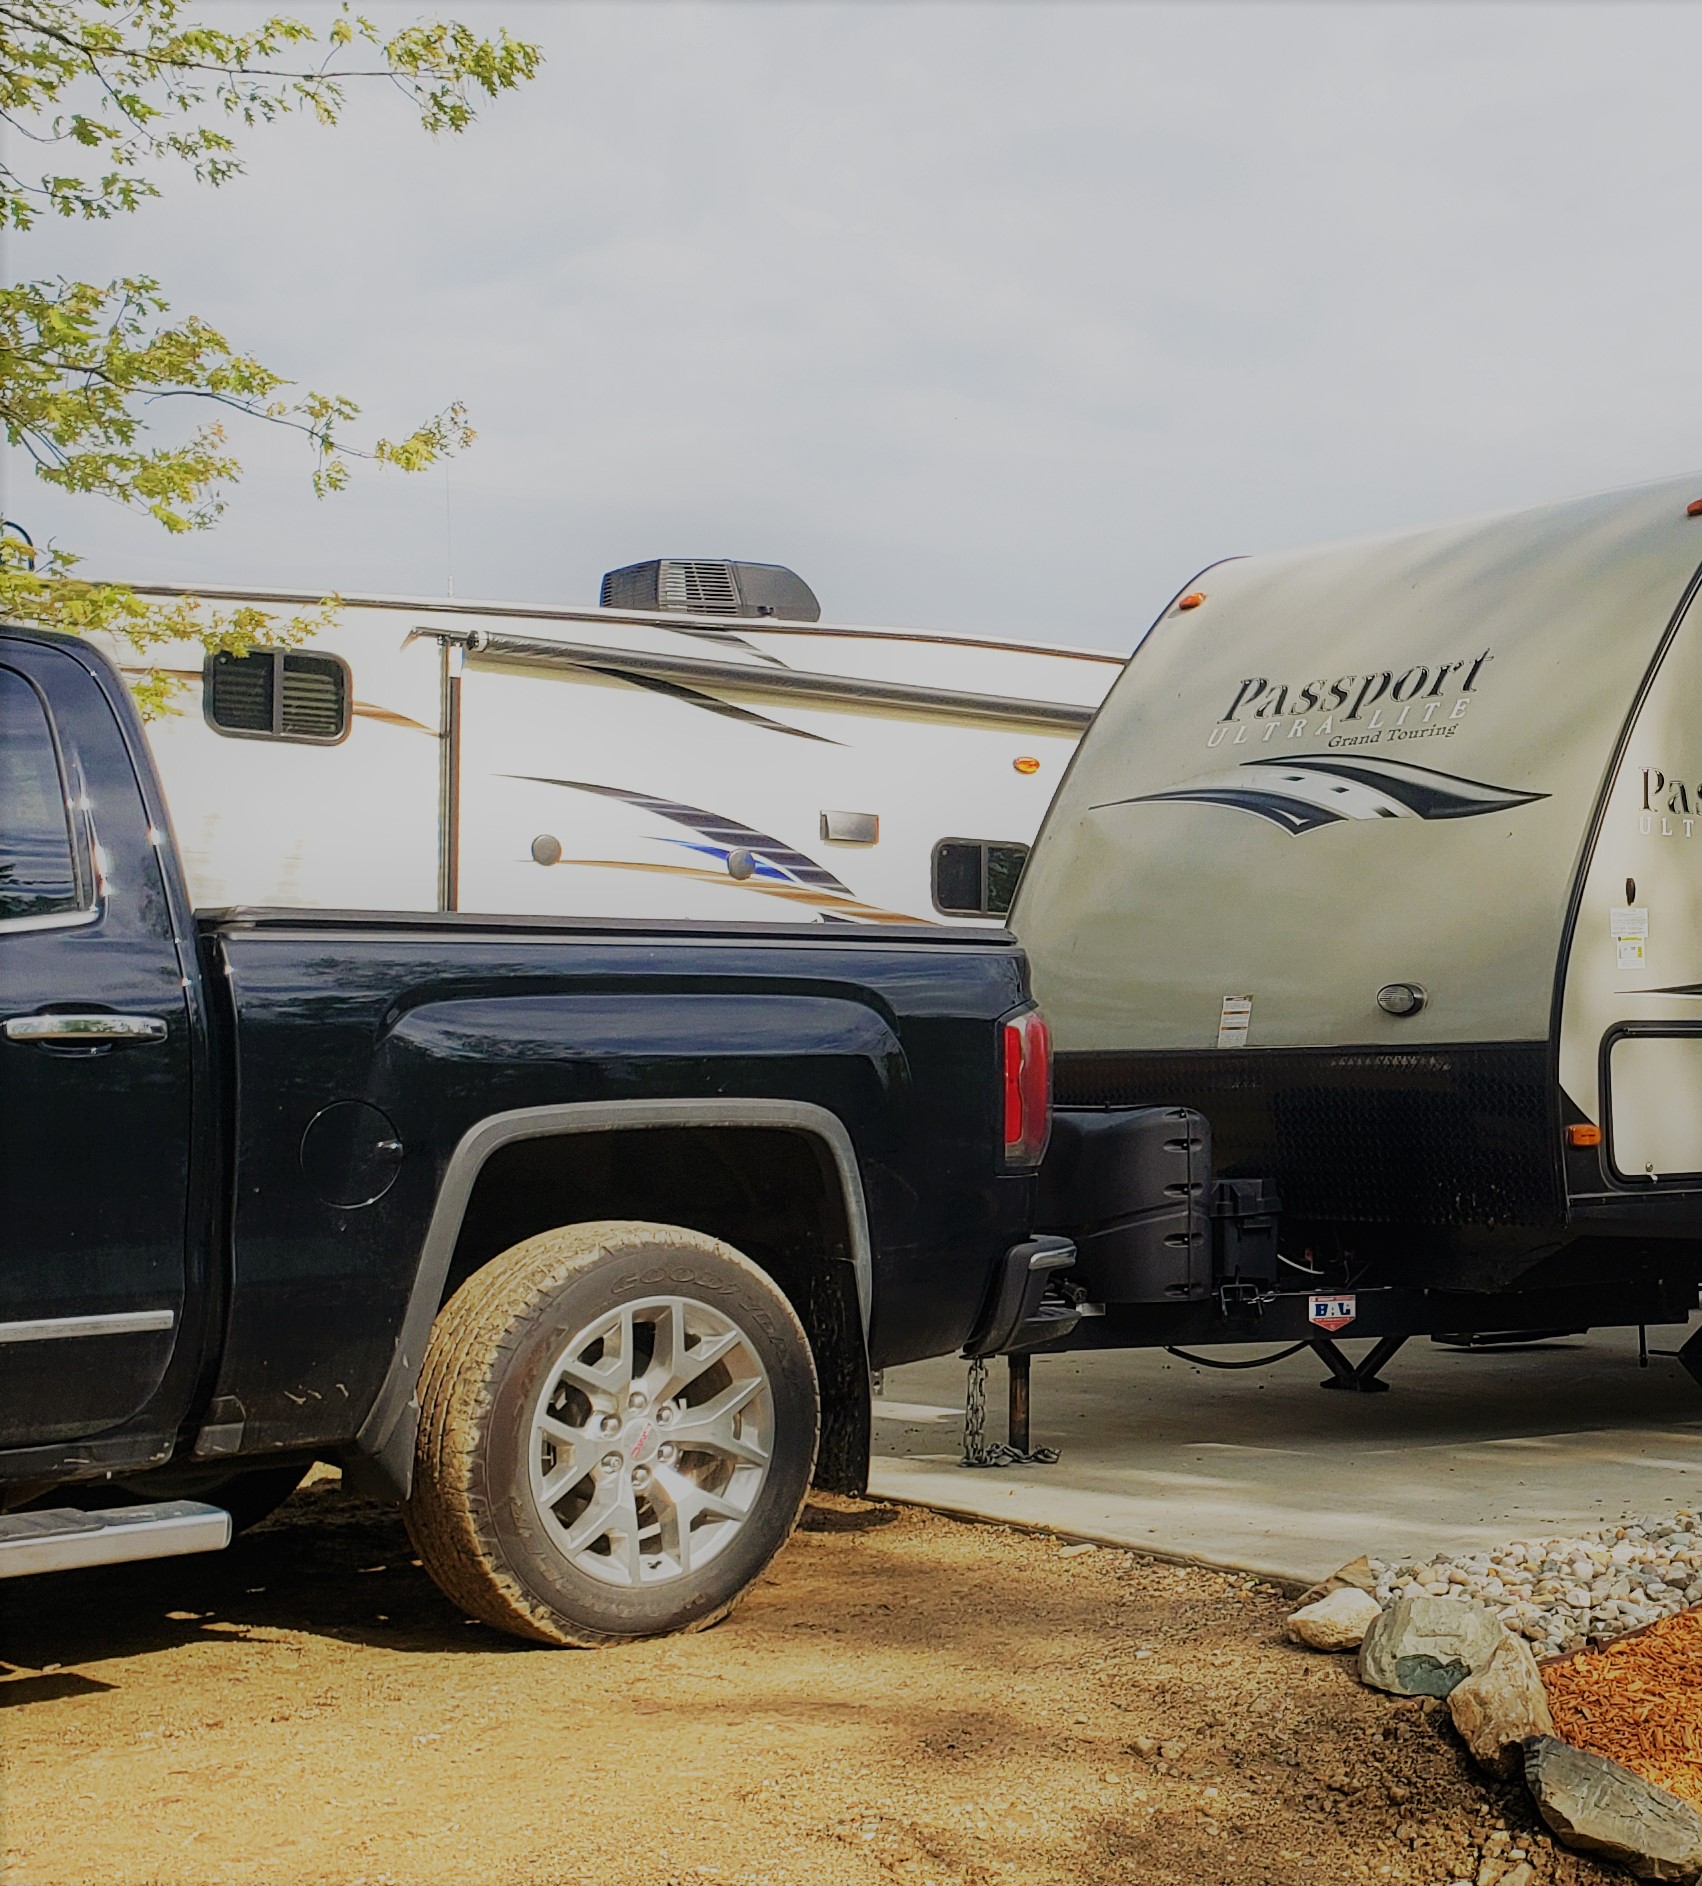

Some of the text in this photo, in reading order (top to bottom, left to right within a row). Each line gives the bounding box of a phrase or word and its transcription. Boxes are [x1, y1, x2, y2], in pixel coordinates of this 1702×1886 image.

[1216, 647, 1494, 724] Passport
[1207, 697, 1471, 748] ULTRA LITE
[1328, 723, 1459, 748] Grand Touring
